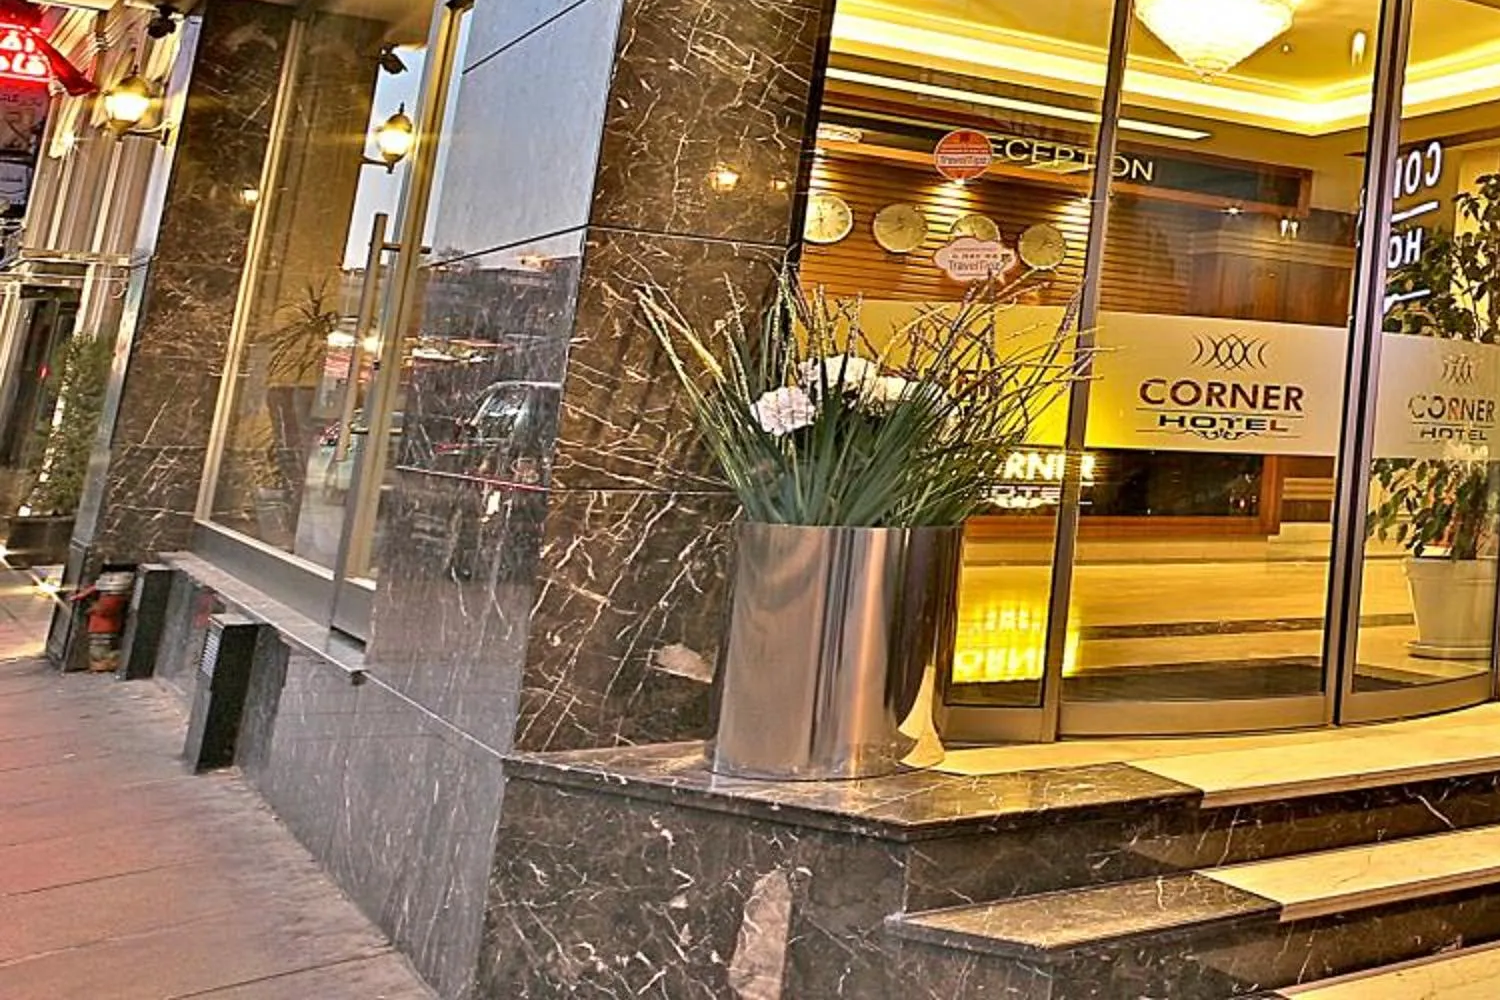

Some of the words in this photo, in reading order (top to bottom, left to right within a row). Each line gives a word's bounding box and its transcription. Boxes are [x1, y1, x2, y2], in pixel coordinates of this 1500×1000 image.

[986, 134, 1154, 181] ECEPTON
[1139, 378, 1304, 412] CORNER
[1407, 395, 1495, 422] CORNER
[1158, 414, 1289, 432] HOTEL
[1420, 427, 1488, 441] HOTEL
